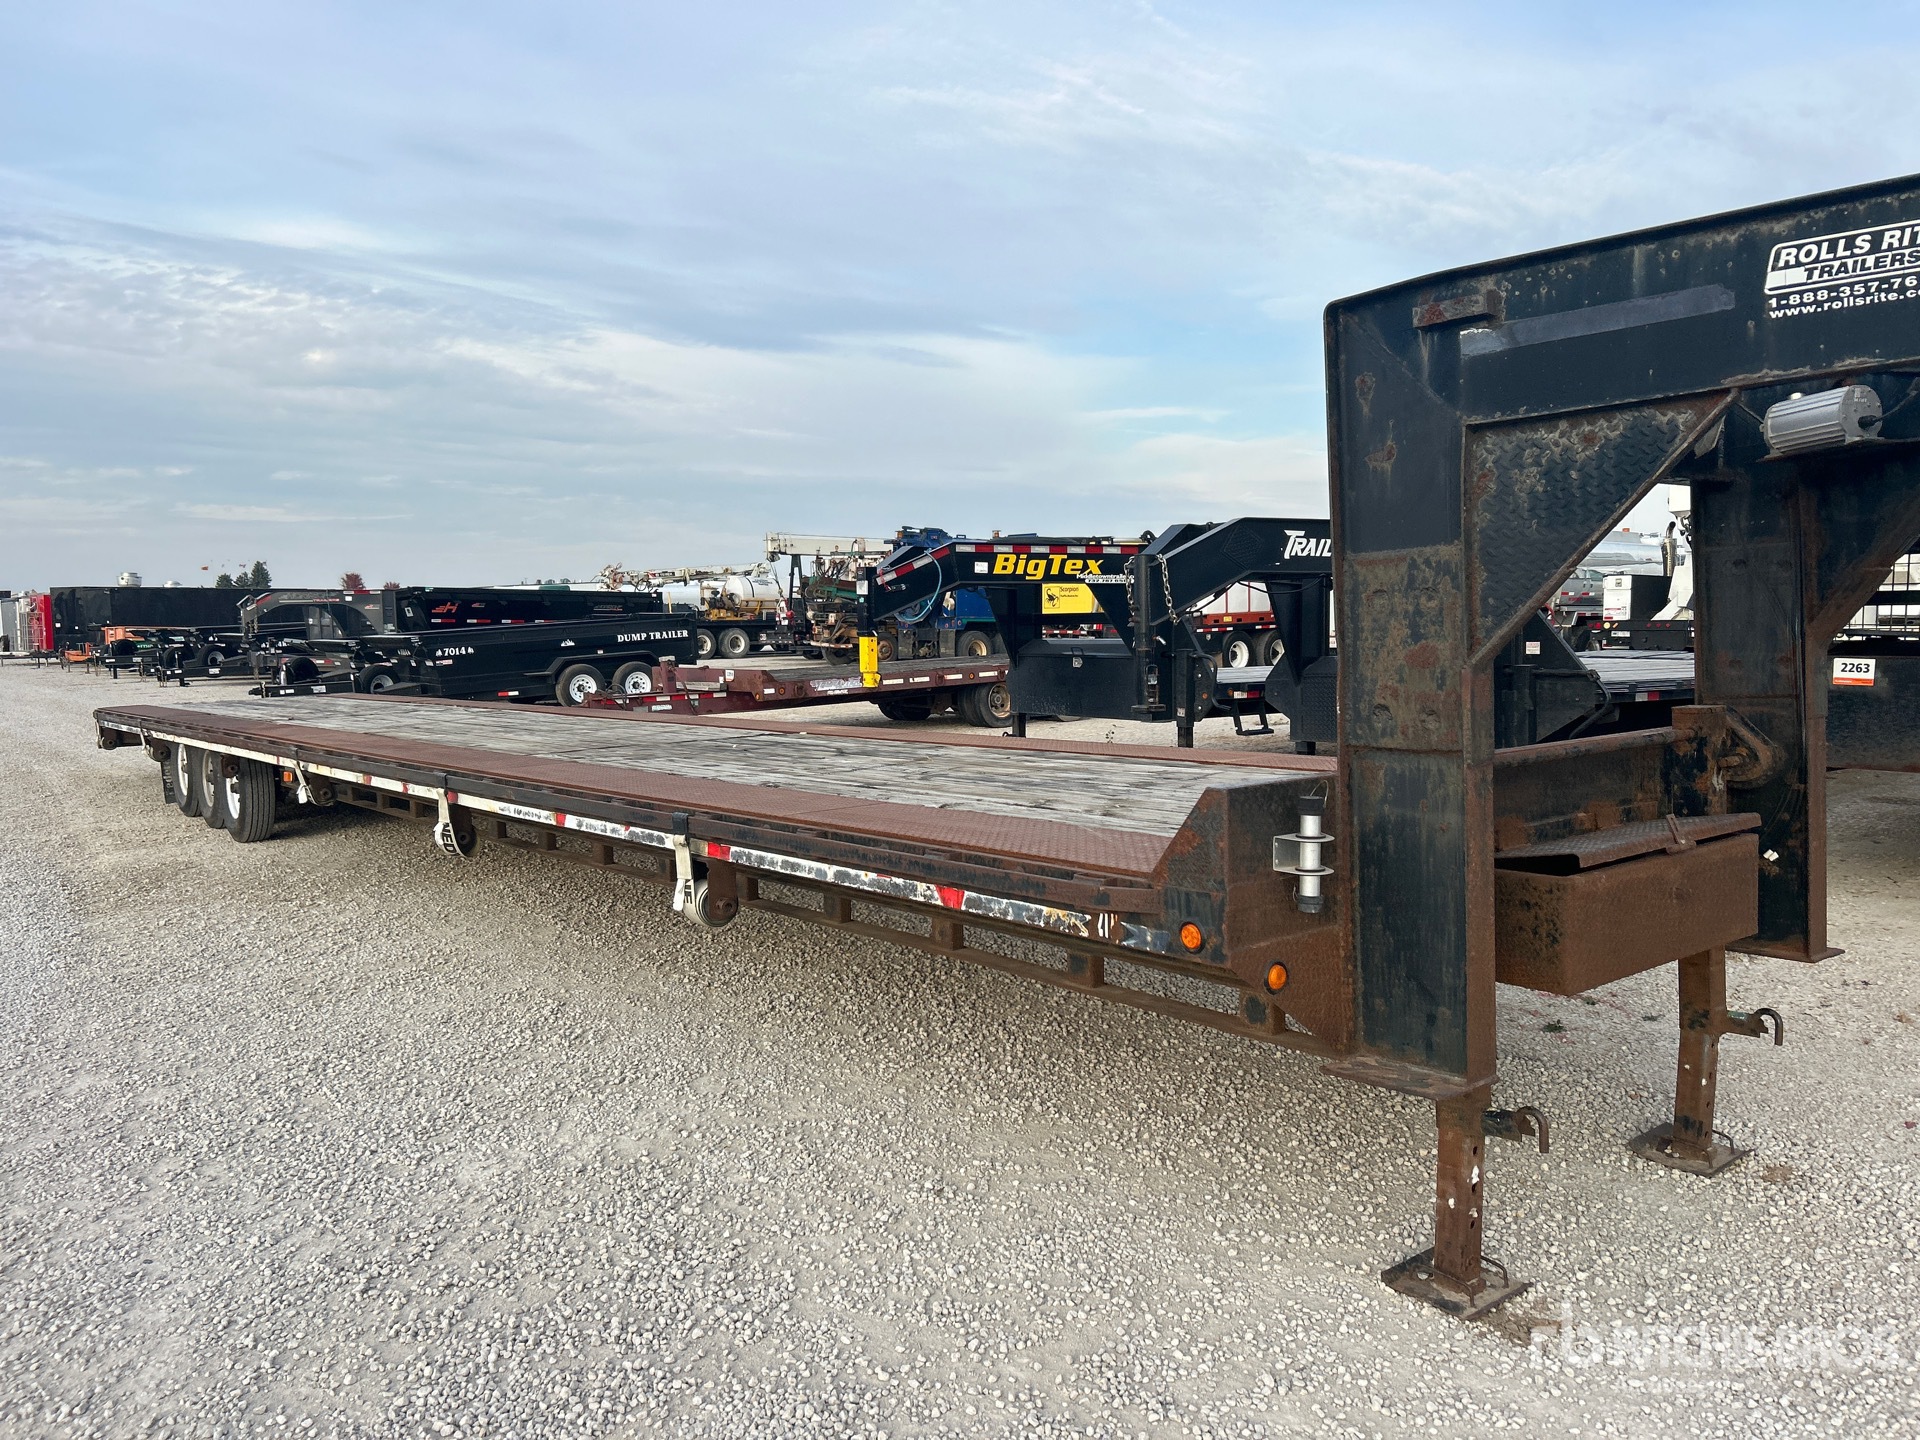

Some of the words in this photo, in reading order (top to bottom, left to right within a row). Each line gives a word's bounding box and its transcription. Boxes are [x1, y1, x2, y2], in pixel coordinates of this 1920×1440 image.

[1777, 234, 1872, 268] ROLLS
[1804, 249, 1920, 281] TRAILERS
[1768, 289, 1920, 319] www.rollsrite.c
[993, 553, 1104, 581] BigTex
[617, 633, 647, 643] DUMP
[648, 629, 689, 640] TRAILER
[443, 646, 467, 657] 7014
[1840, 662, 1871, 674] 2263
